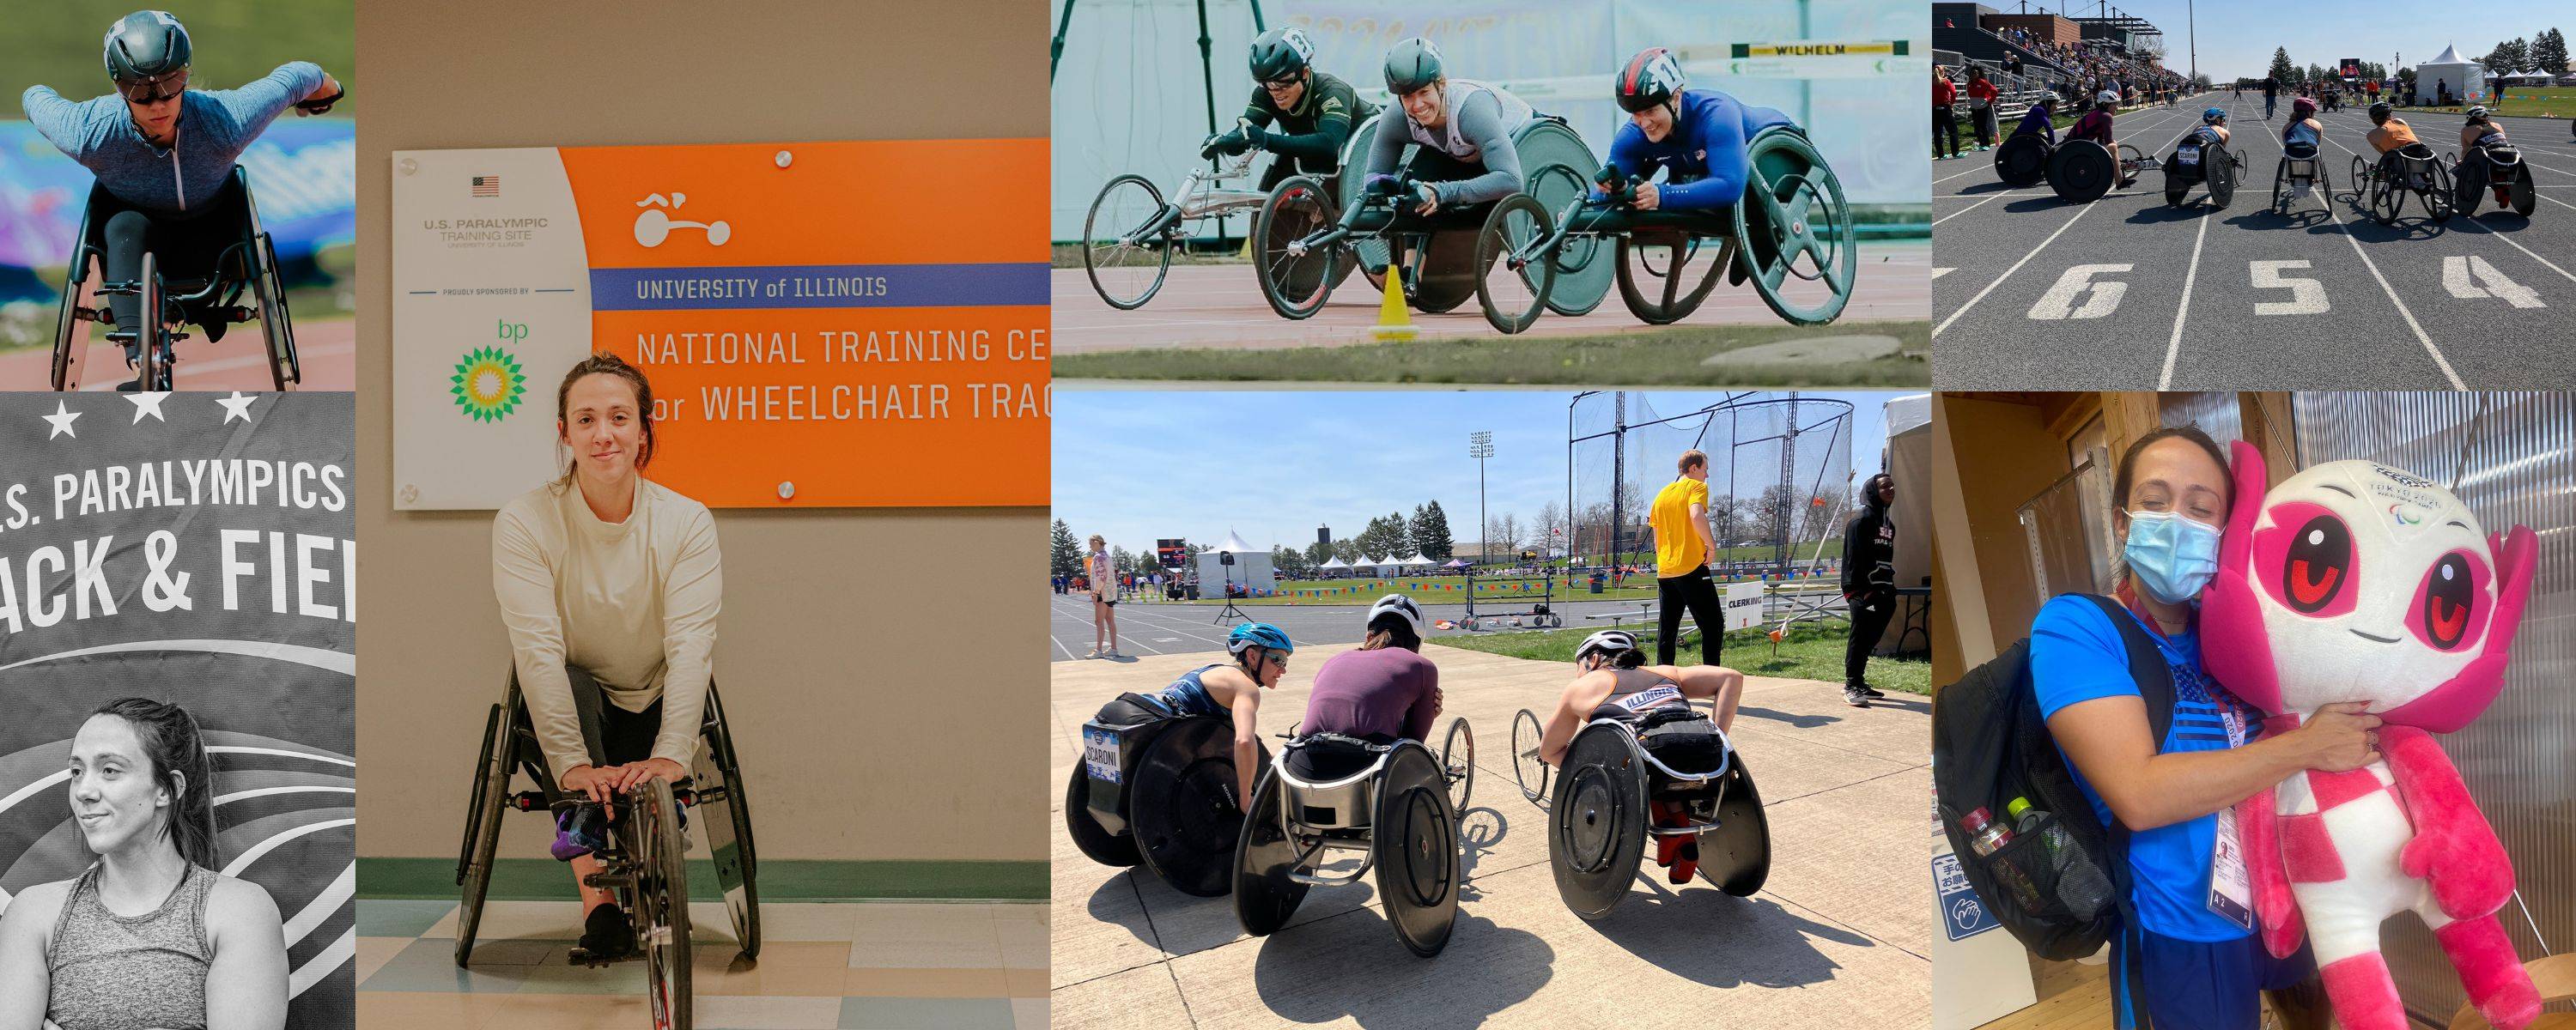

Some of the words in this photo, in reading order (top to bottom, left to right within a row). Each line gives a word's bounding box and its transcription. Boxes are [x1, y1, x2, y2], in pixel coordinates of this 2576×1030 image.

[1774, 45, 1845, 56] WILHELM
[424, 219, 452, 230] U.S.
[456, 218, 549, 229] PARALYMPIC
[440, 231, 501, 241] TRAINING
[505, 230, 532, 240] SITE
[637, 279, 758, 300] UNIVERSITY
[766, 278, 787, 298] of
[793, 277, 887, 297] ILLINOIS
[2027, 263, 2134, 320] 6
[2250, 260, 2330, 316] 5
[2442, 256, 2547, 309] 4
[499, 318, 528, 344] bp
[637, 332, 805, 365] NATIONAL
[819, 330, 989, 362] TRAINING
[1007, 330, 1046, 361] CE
[651, 398, 685, 421] or
[701, 385, 949, 421] WHEELCHAIR
[54, 459, 346, 520] PARALYMPICS
[142, 530, 192, 612] &
[1728, 596, 1762, 609] CLERKING
[1625, 687, 1674, 708] ILLINOIS
[2224, 717, 2238, 740] 2020
[1086, 745, 1117, 766] SCARONI
[1222, 783, 1236, 809] HONDA
